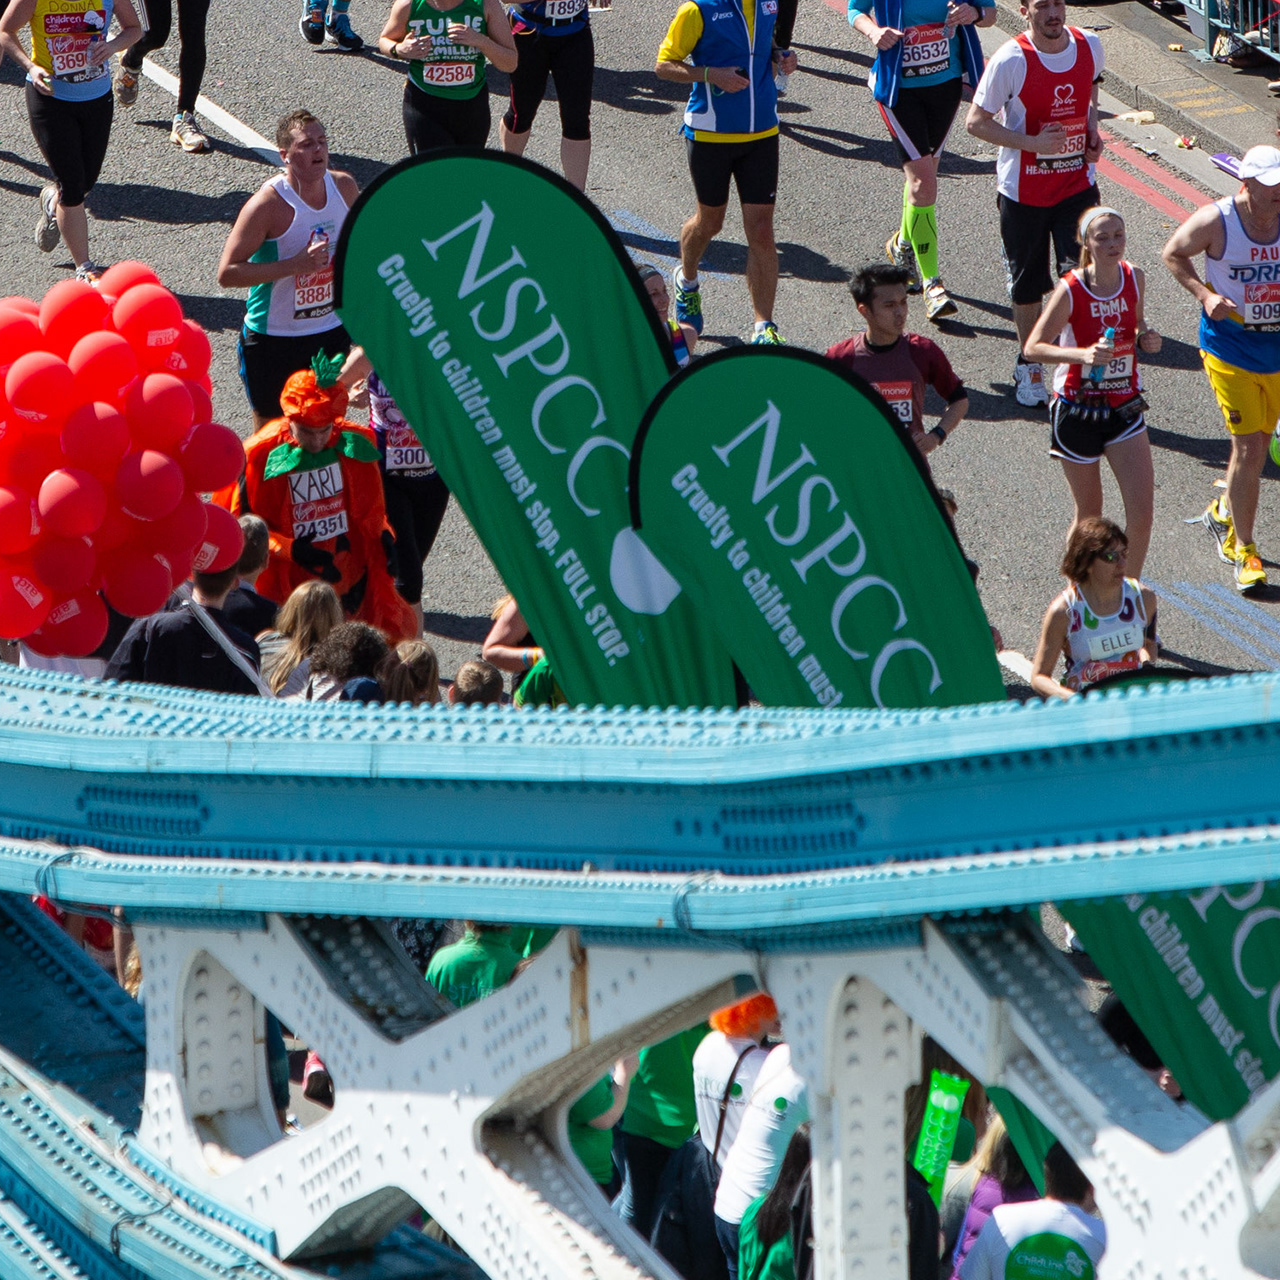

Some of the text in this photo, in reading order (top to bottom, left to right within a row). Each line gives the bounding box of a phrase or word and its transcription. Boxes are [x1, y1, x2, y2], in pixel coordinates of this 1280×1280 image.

[44, 13, 82, 27] children
[903, 41, 949, 62] 56532
[919, 61, 950, 76] #boost
[425, 65, 474, 83] 42584
[1052, 158, 1083, 169] #boost
[296, 286, 332, 304] 3884
[377, 252, 436, 338] Cruelty
[1090, 300, 1129, 318] EMMA
[422, 200, 632, 518] NSPCC
[427, 326, 453, 364] to
[439, 354, 494, 441] children
[1098, 378, 1131, 391] #boost
[289, 465, 342, 507] KARL
[483, 438, 531, 506] must
[317, 500, 342, 514] money
[524, 498, 561, 559] stop.
[670, 462, 733, 552] Cruelty
[726, 535, 753, 574] to
[740, 564, 800, 659] children
[711, 399, 942, 710] NSPCC
[552, 549, 594, 615] FULL
[1101, 634, 1134, 655] ELLE
[1138, 906, 1245, 1057] children must
